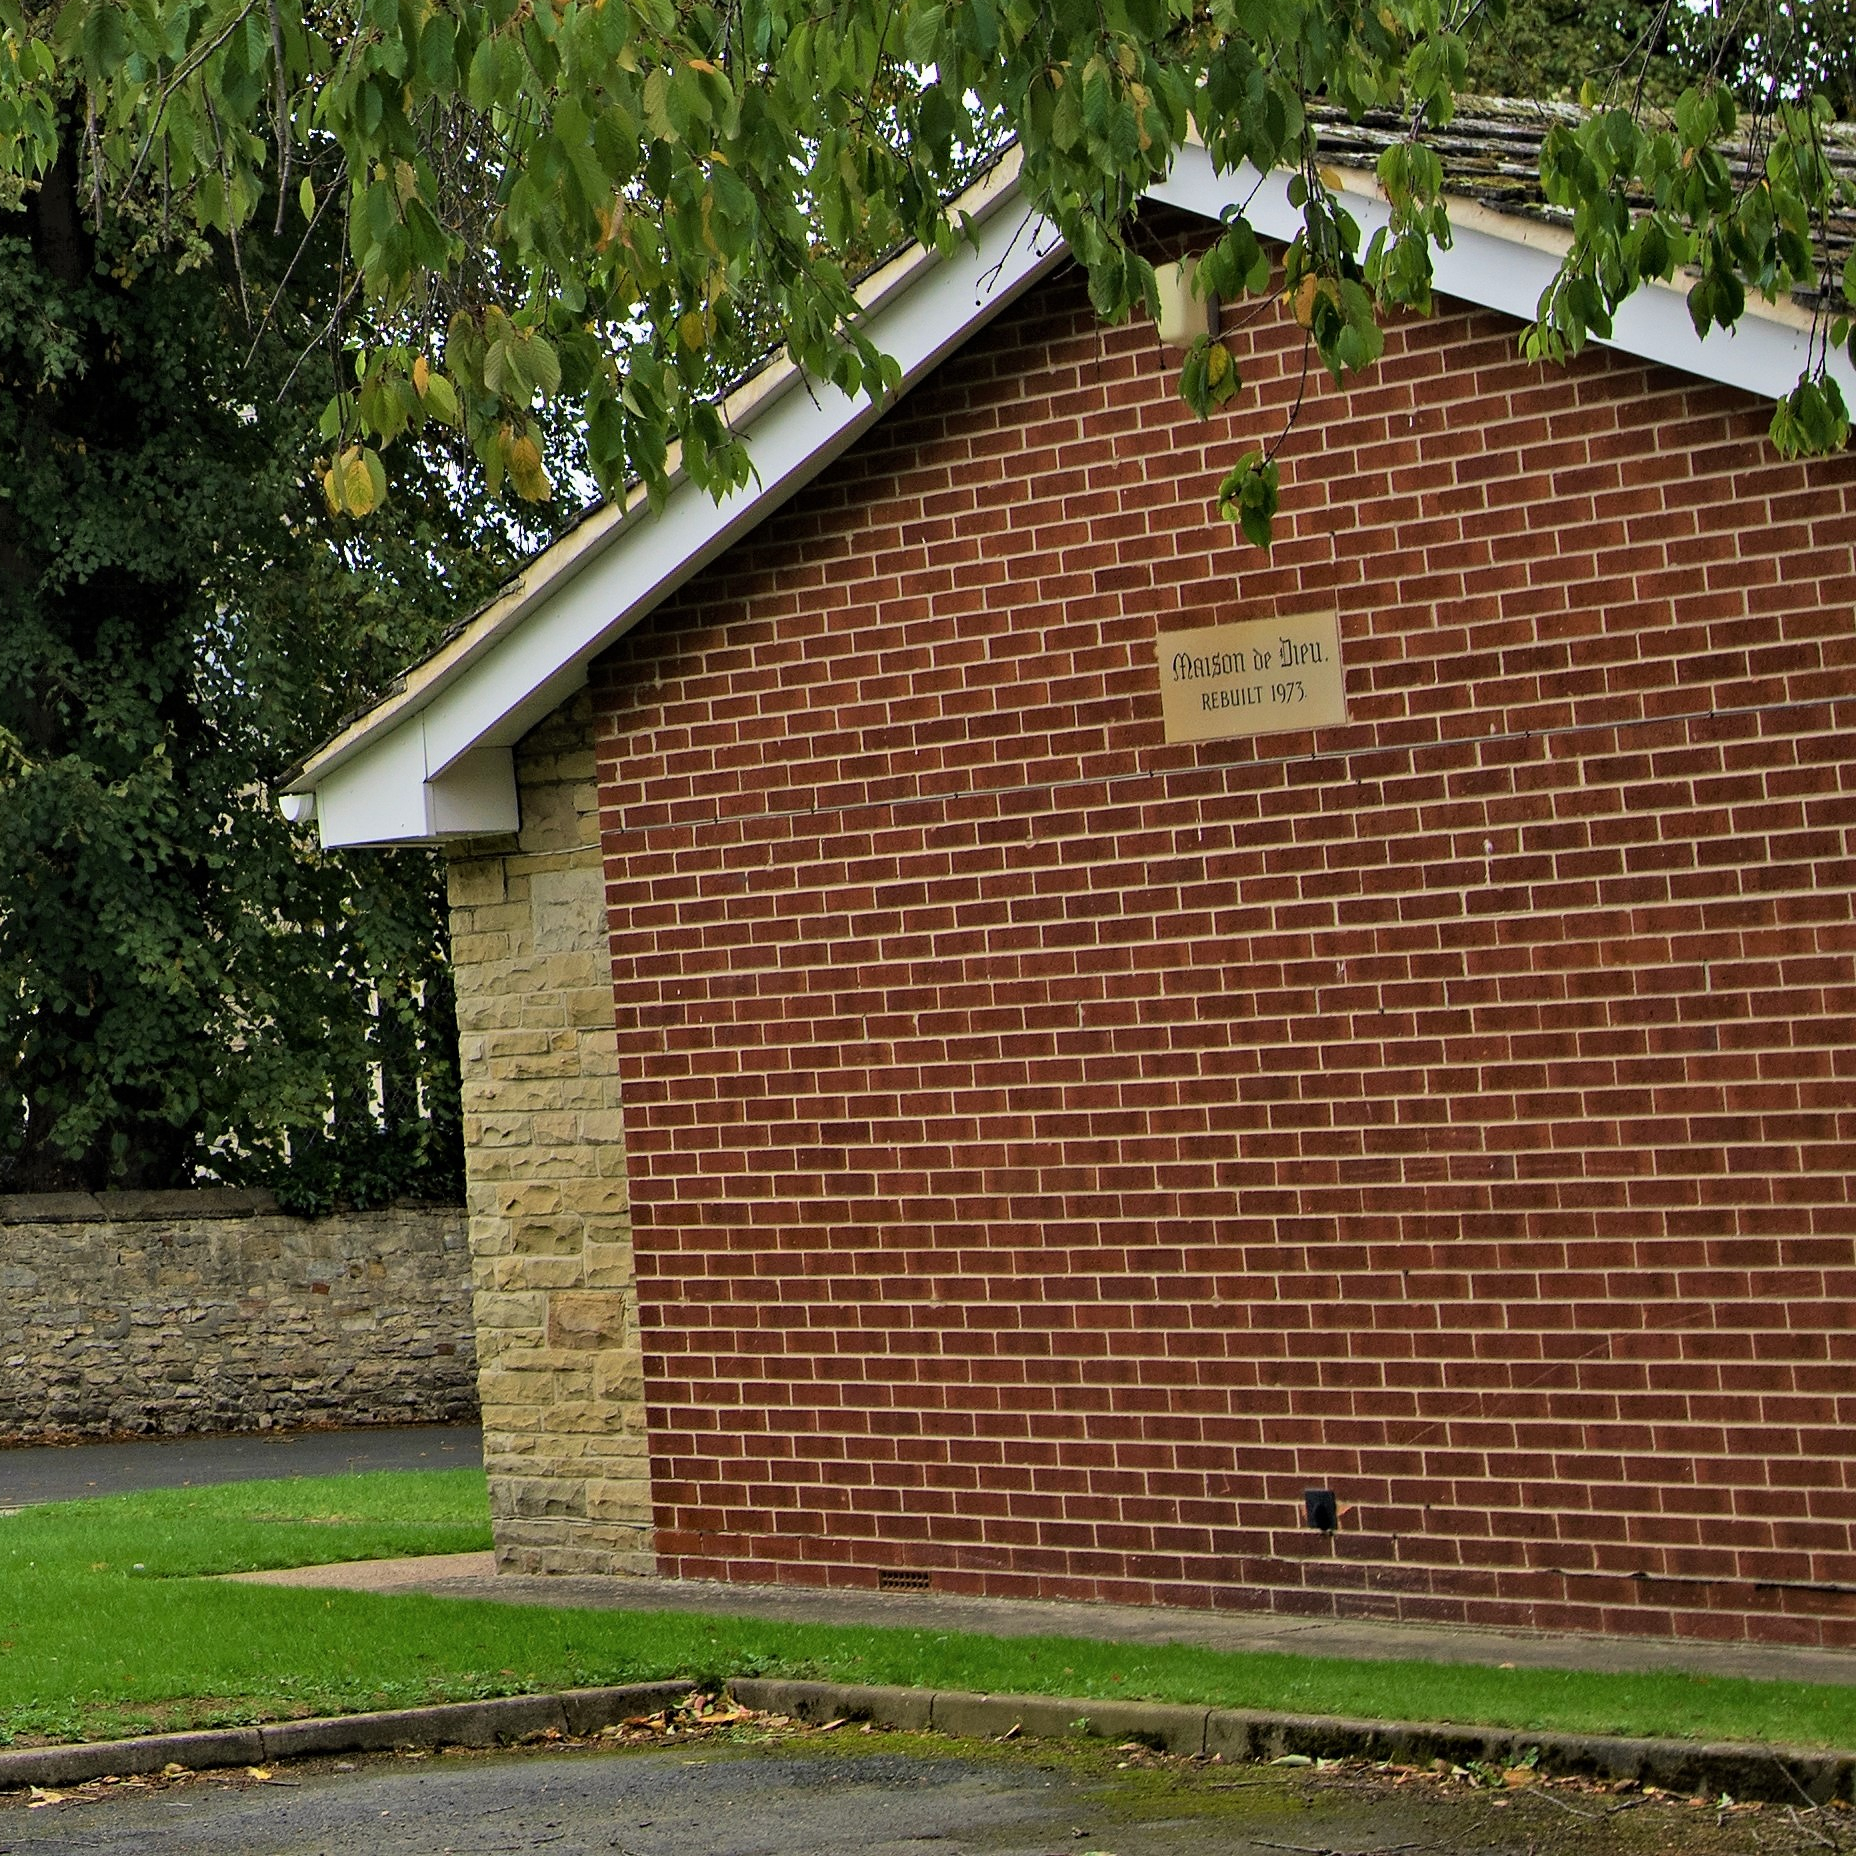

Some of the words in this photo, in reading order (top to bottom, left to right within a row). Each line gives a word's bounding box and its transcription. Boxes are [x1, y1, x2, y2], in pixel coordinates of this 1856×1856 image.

[1172, 651, 1246, 682] Maison
[1252, 647, 1272, 672] de
[1279, 635, 1329, 668] Dieu.
[1202, 685, 1264, 711] REBUILT
[1271, 680, 1308, 704] 1973.
